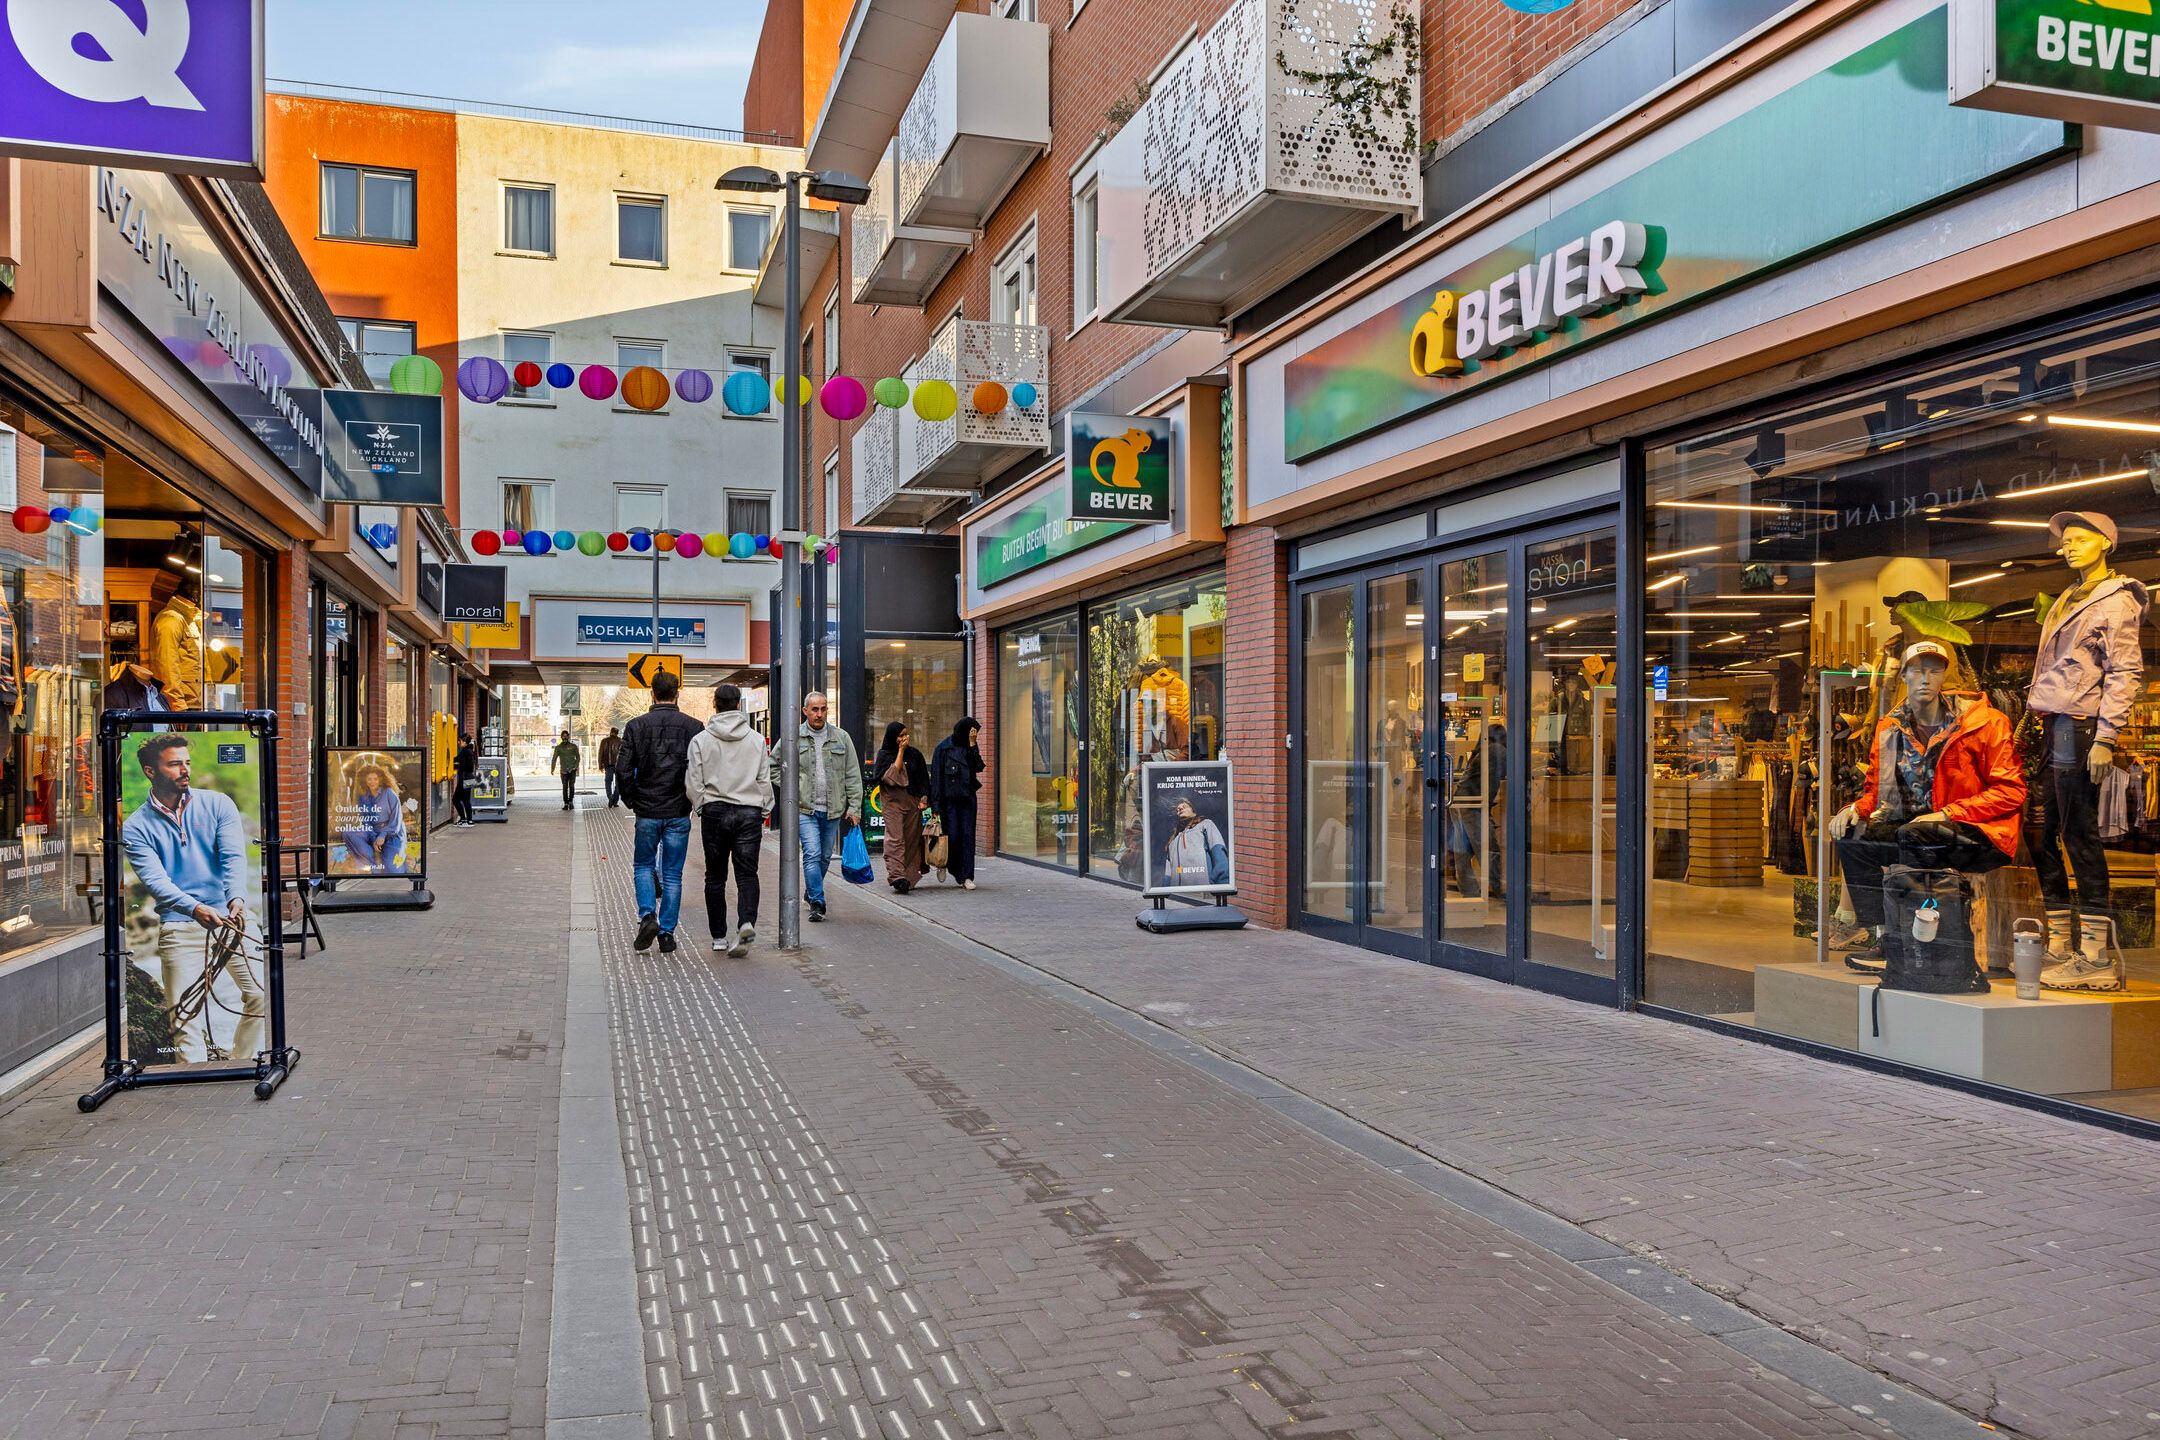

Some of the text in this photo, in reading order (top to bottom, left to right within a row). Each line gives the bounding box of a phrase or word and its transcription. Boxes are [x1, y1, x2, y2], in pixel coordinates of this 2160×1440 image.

[7, 0, 206, 112] Q
[1456, 219, 1647, 360] BEVER
[158, 232, 198, 318] NEW
[206, 291, 269, 395] ZEALAND
[375, 448, 415, 457] ZEALAND
[359, 455, 407, 464] AUCKLAND
[1089, 491, 1153, 511] BEVER
[1002, 535, 1025, 564] BUITEN
[1026, 522, 1052, 554] BEGINT
[1052, 516, 1064, 542] BIJ
[1541, 553, 1564, 567] KASSA
[455, 605, 502, 617] norah
[586, 623, 684, 638] BOEKHANDEL
[335, 804, 382, 813] Ontdek de
[335, 813, 379, 823] voorjaars
[16, 826, 26, 837] NE
[334, 823, 374, 832] collectie
[26, 839, 66, 858] OLLECTION
[1182, 866, 1206, 874] BEVER
